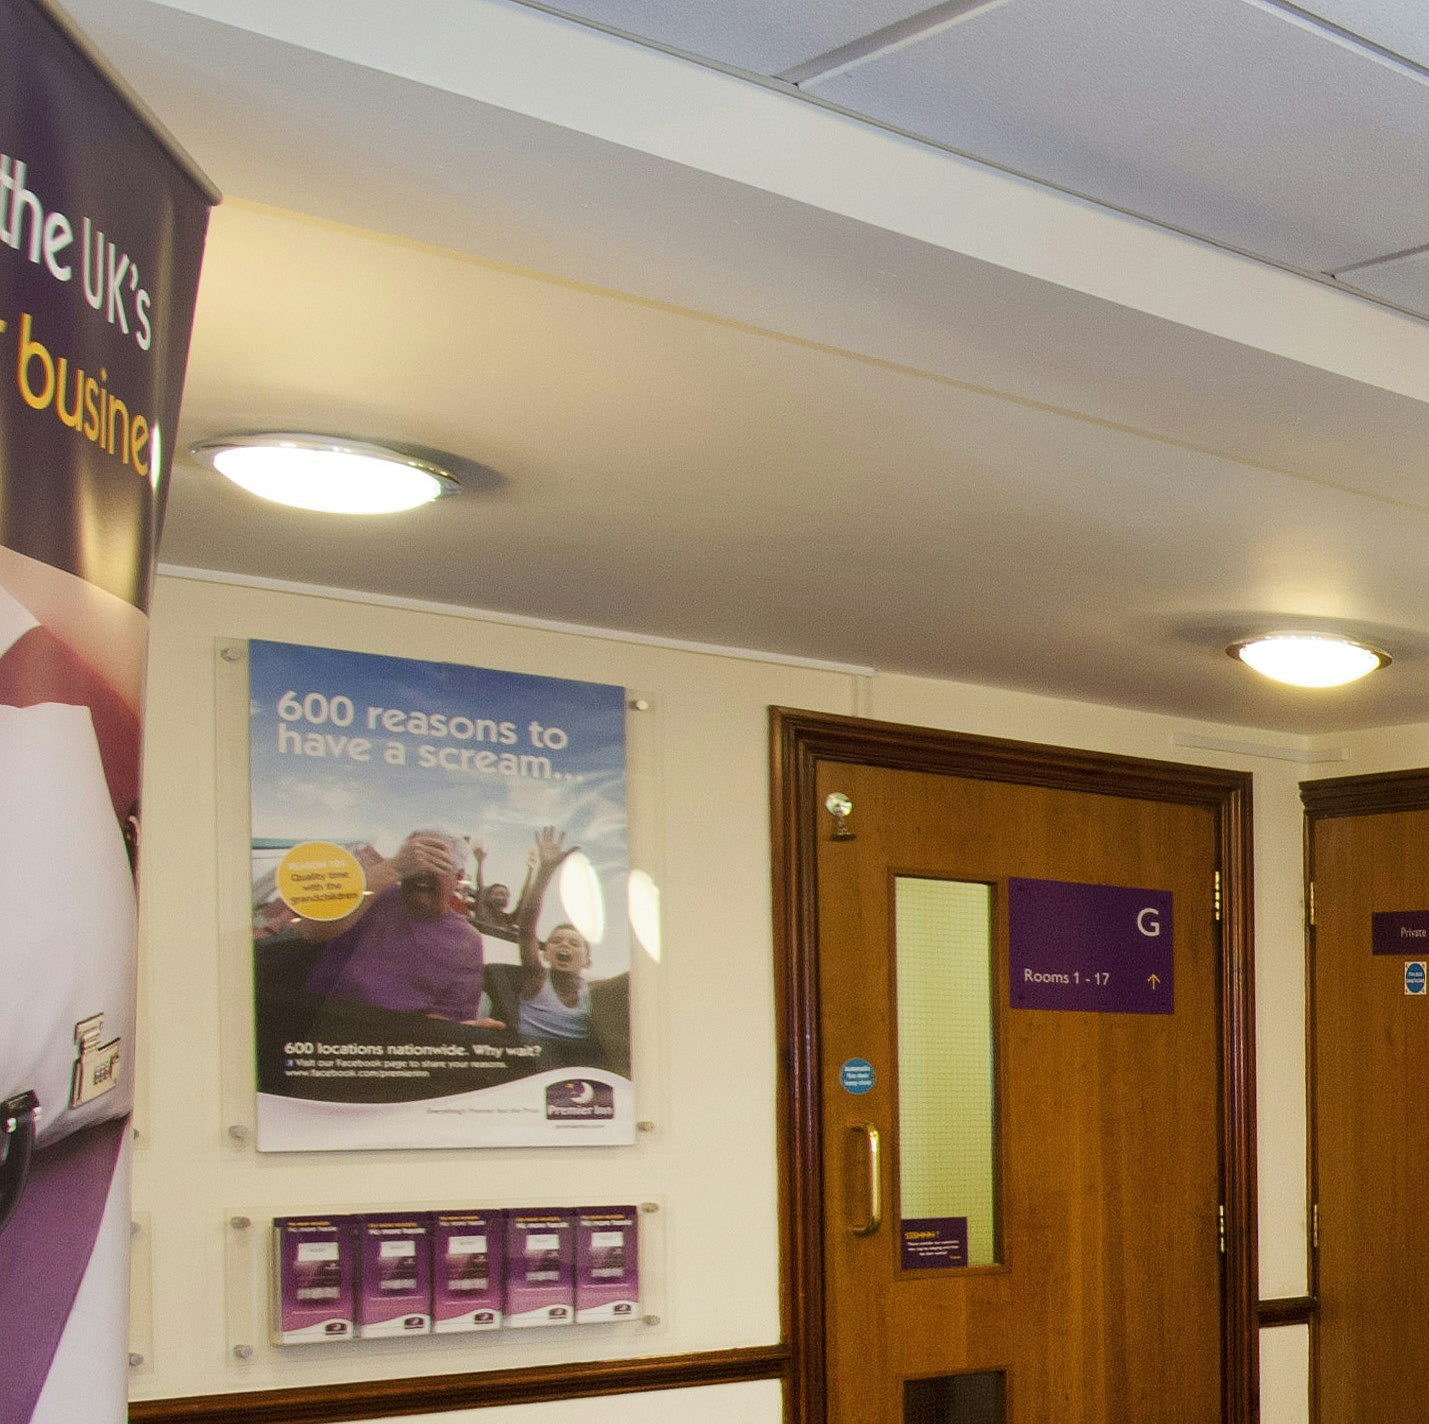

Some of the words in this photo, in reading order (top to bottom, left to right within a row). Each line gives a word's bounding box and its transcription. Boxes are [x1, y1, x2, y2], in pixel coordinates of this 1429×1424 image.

[0, 153, 73, 282] the
[82, 216, 151, 351] UK's
[17, 312, 149, 476] busine
[277, 691, 354, 727] 600
[367, 706, 517, 745] reasons
[528, 720, 568, 750] to
[277, 722, 371, 761] have
[383, 741, 406, 765] a
[417, 743, 584, 780] scream...
[1137, 907, 1160, 937] G
[1401, 927, 1427, 938] Private
[1024, 968, 1070, 984] Rooms
[1073, 971, 1080, 984] 1
[1094, 972, 1110, 985] 17
[284, 1041, 314, 1055] 600
[317, 1042, 384, 1056] locations
